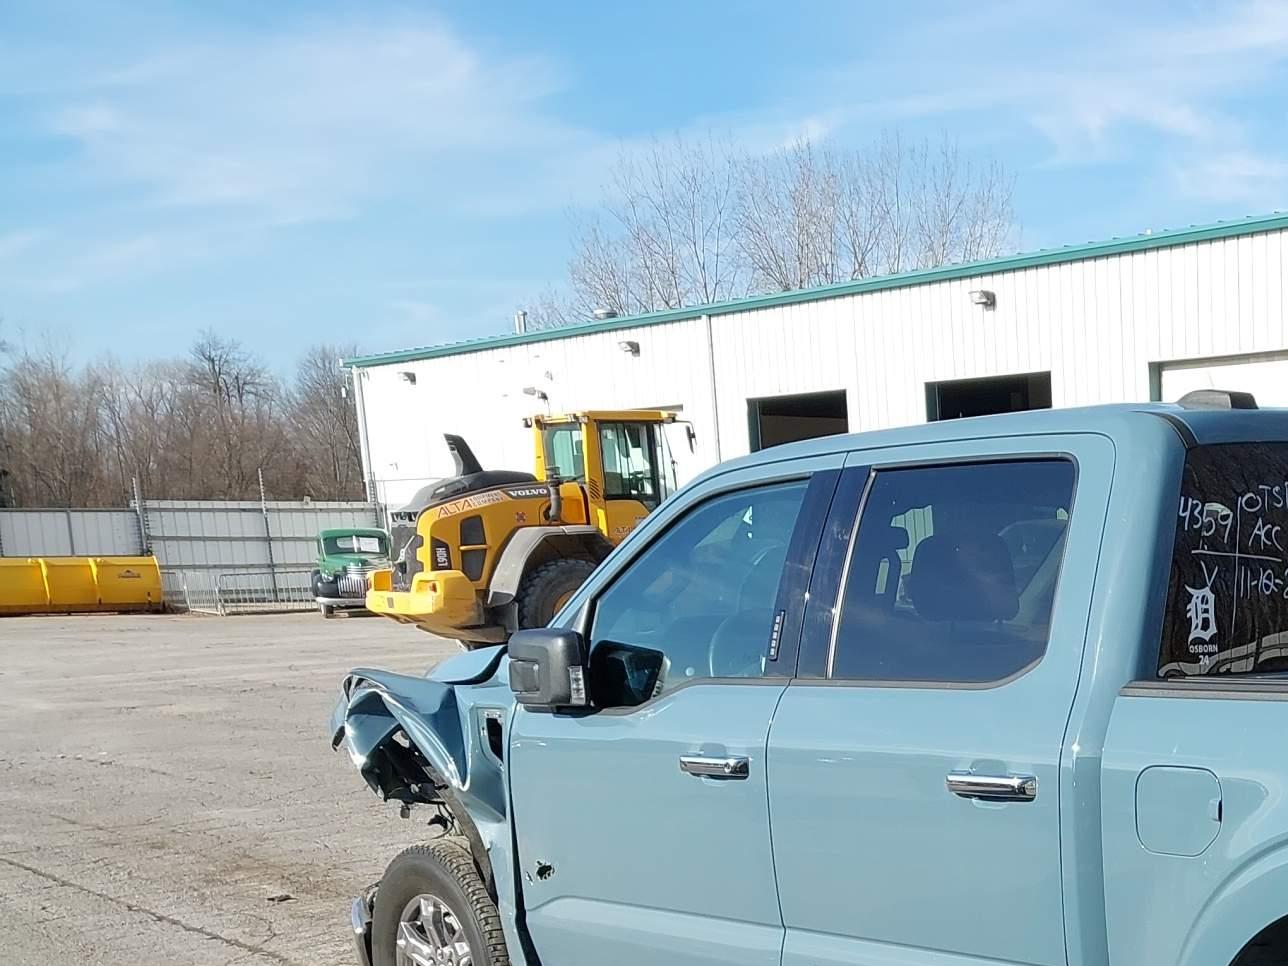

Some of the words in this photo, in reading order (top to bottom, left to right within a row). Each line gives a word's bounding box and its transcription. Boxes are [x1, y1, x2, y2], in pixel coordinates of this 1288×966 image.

[508, 487, 548, 497] VOLVO
[438, 499, 473, 518] ALTA
[435, 547, 448, 567] L90H
[1189, 644, 1218, 654] OSBORN
[1199, 654, 1210, 666] 24
